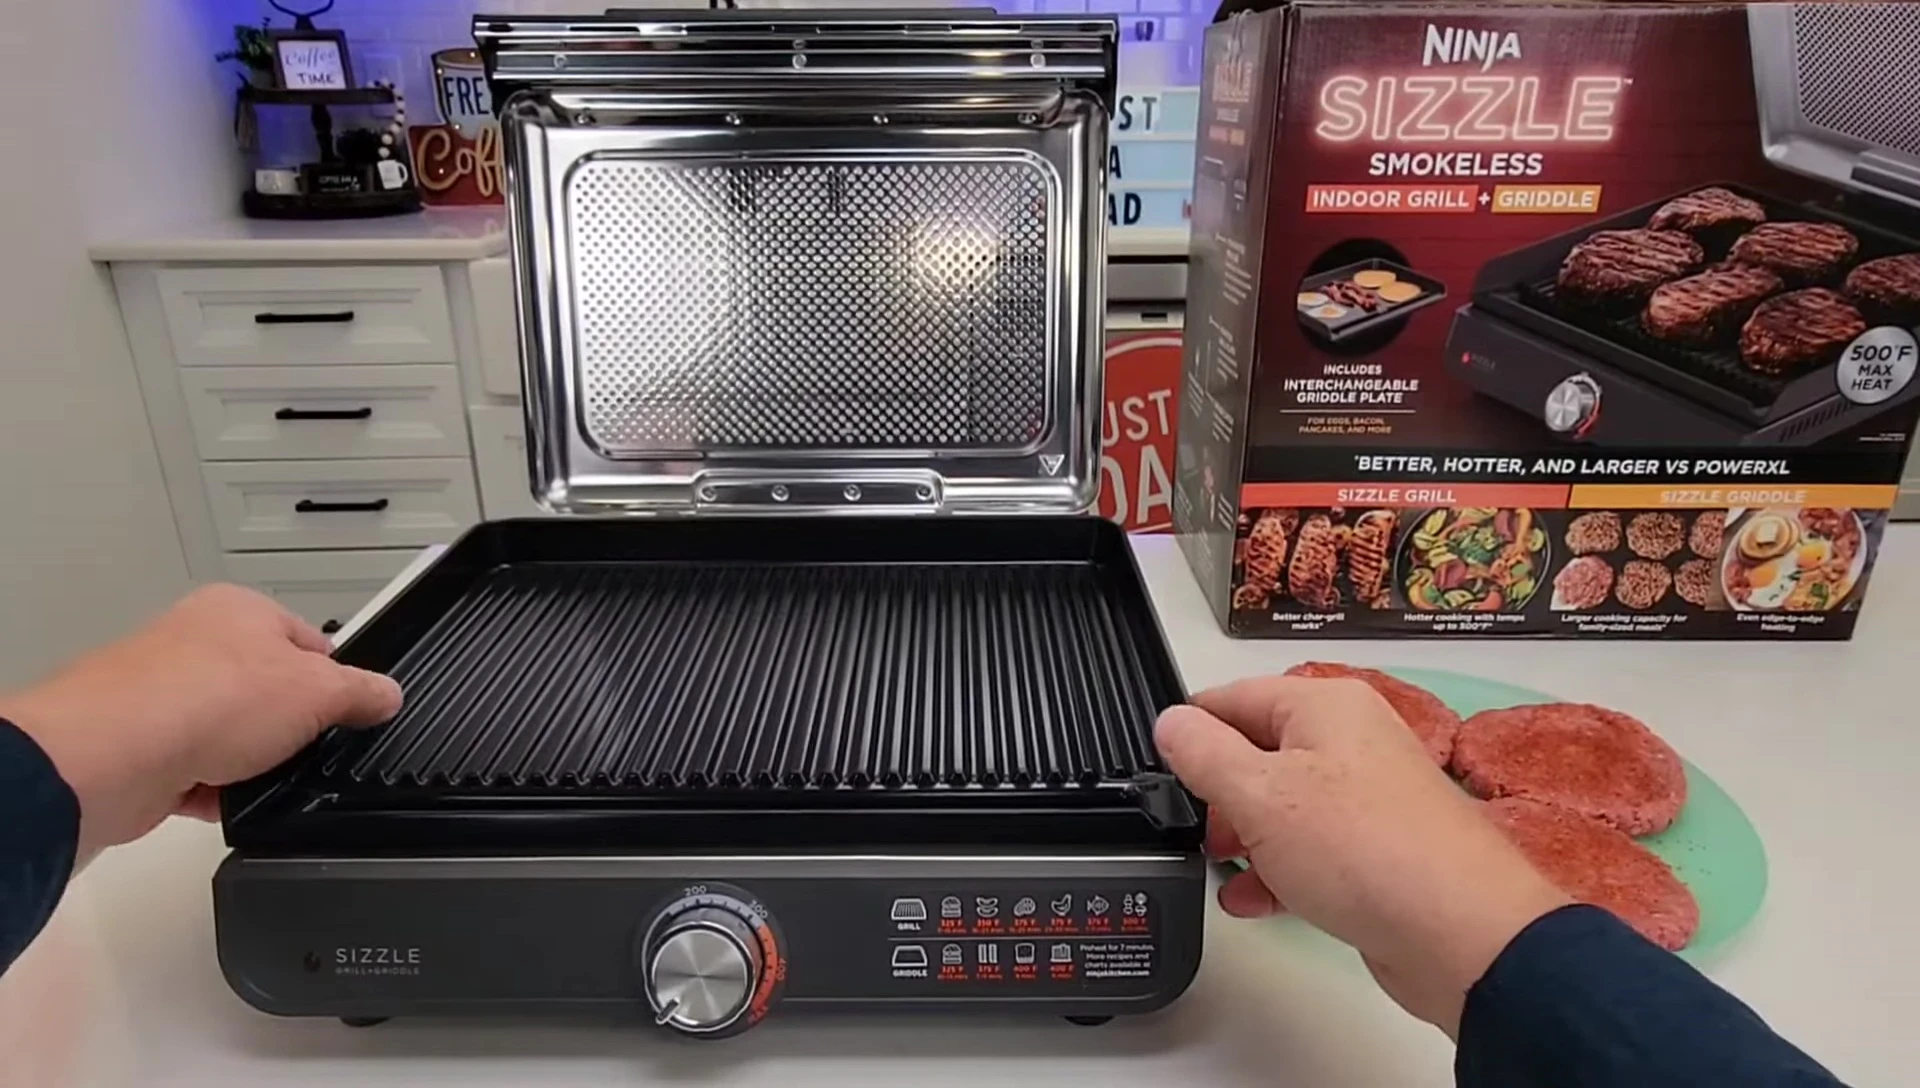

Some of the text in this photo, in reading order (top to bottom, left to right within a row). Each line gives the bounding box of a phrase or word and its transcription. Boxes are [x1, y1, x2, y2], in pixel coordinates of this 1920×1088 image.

[1422, 24, 1522, 72] NINJA
[297, 72, 336, 84] TIME
[1315, 75, 1622, 142] SIZZLE
[1369, 153, 1544, 176] SMOKELESS
[1313, 191, 1400, 208] INDOOR
[1407, 191, 1470, 208] GRILL
[1498, 191, 1593, 208] GRIDDLE
[1323, 364, 1383, 375] INCLUDES
[1858, 364, 1894, 376] MAX
[1283, 379, 1419, 392] INTERCHANGEABLE
[1851, 378, 1893, 390] HEAT
[1297, 391, 1404, 403] GRIDDLE PLATE
[1443, 457, 1527, 476] HOTTER,
[1531, 459, 1576, 474] AND
[1581, 459, 1660, 474] LARGER
[1665, 459, 1690, 474] VS
[1693, 459, 1791, 474] POWERXL
[1336, 489, 1457, 503] SIZZLE GRILL
[1659, 490, 1808, 504] SIZZLE GRIDDLE
[1272, 612, 1301, 621] Better
[1403, 613, 1526, 623] Hotter cooking with temps
[1433, 622, 1446, 631] up
[1446, 622, 1458, 630] to
[684, 885, 707, 897] 200
[897, 922, 921, 931] GRILL
[1108, 943, 1119, 951] for
[336, 947, 421, 963] SIZZLE
[892, 968, 928, 977] GRIDDLE
